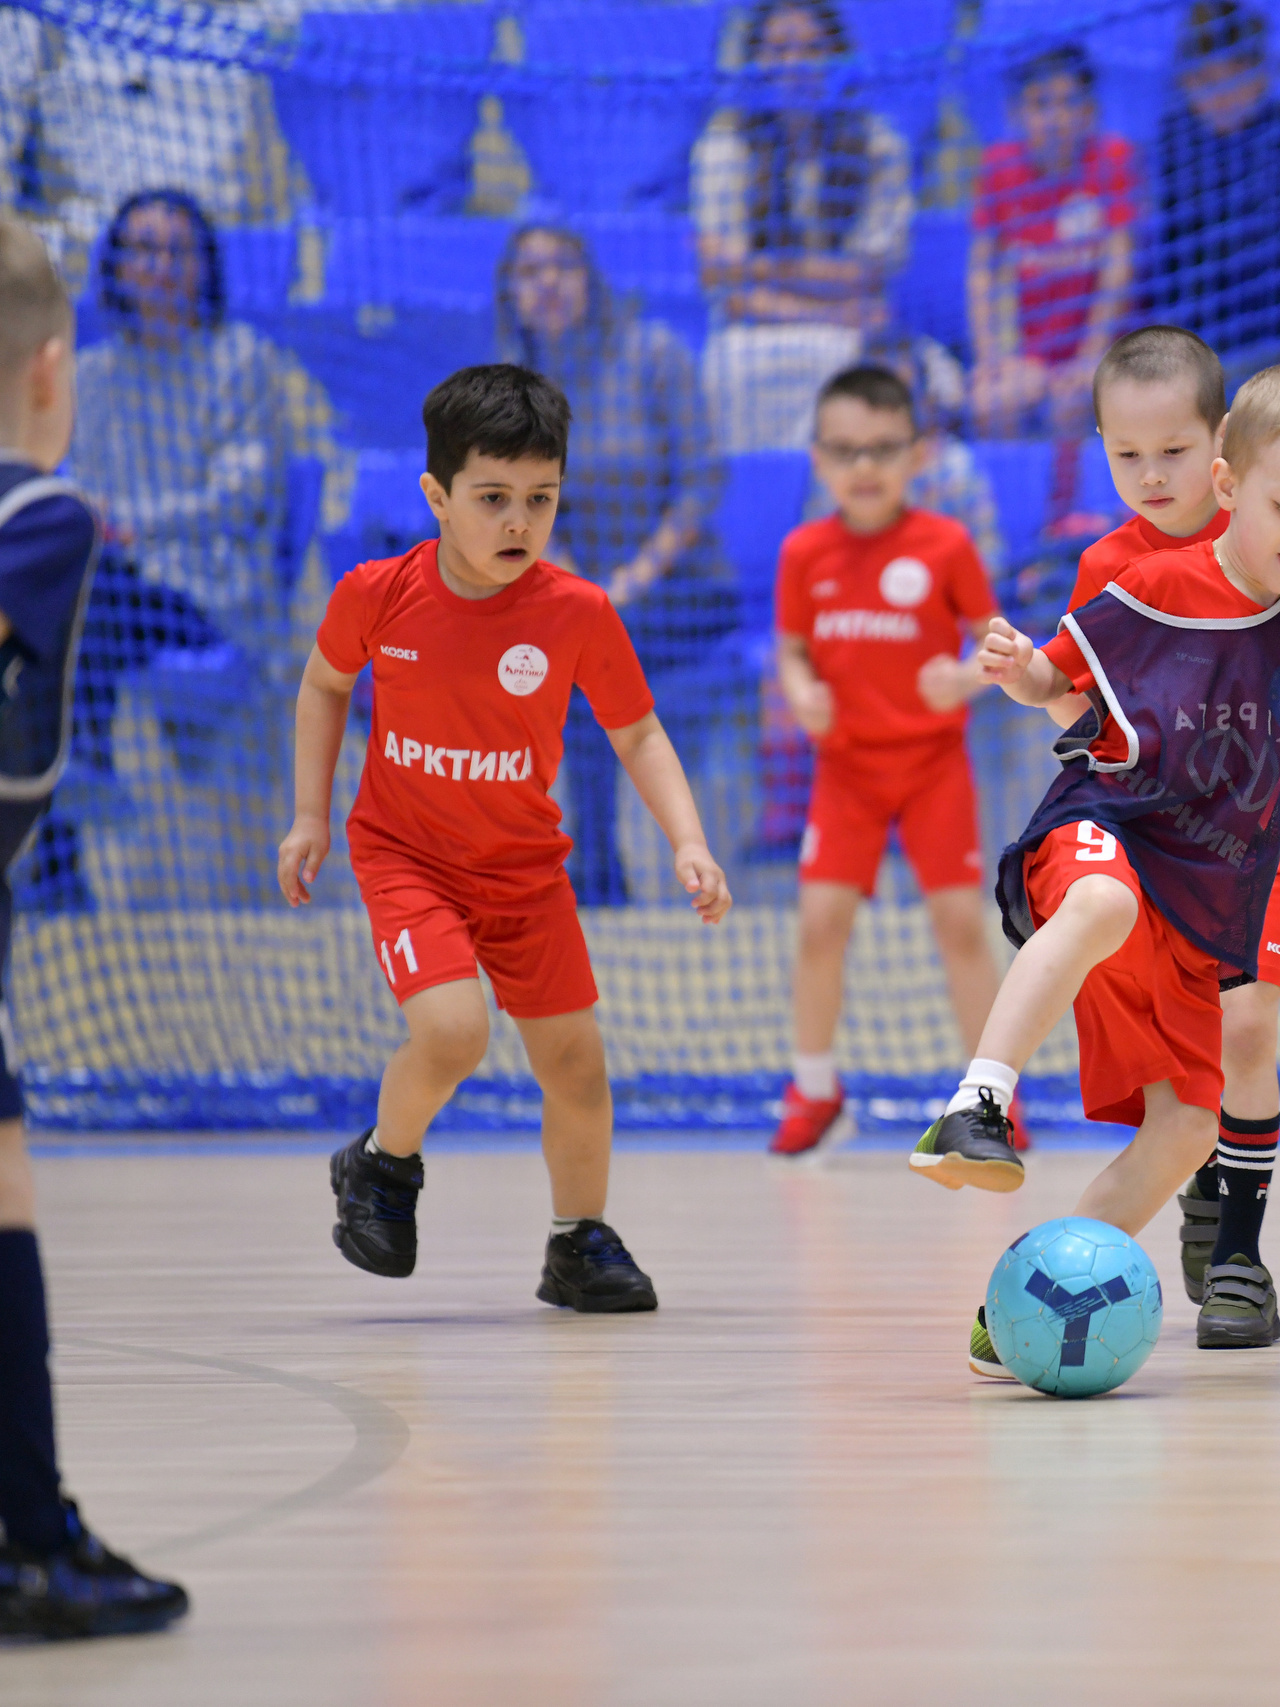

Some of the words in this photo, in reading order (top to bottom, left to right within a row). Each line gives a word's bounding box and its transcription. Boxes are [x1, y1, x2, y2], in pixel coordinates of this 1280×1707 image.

[380, 645, 418, 661] KODES
[384, 730, 532, 781] АРКТИКА
[1075, 820, 1116, 861] 9
[380, 928, 419, 985] 11
